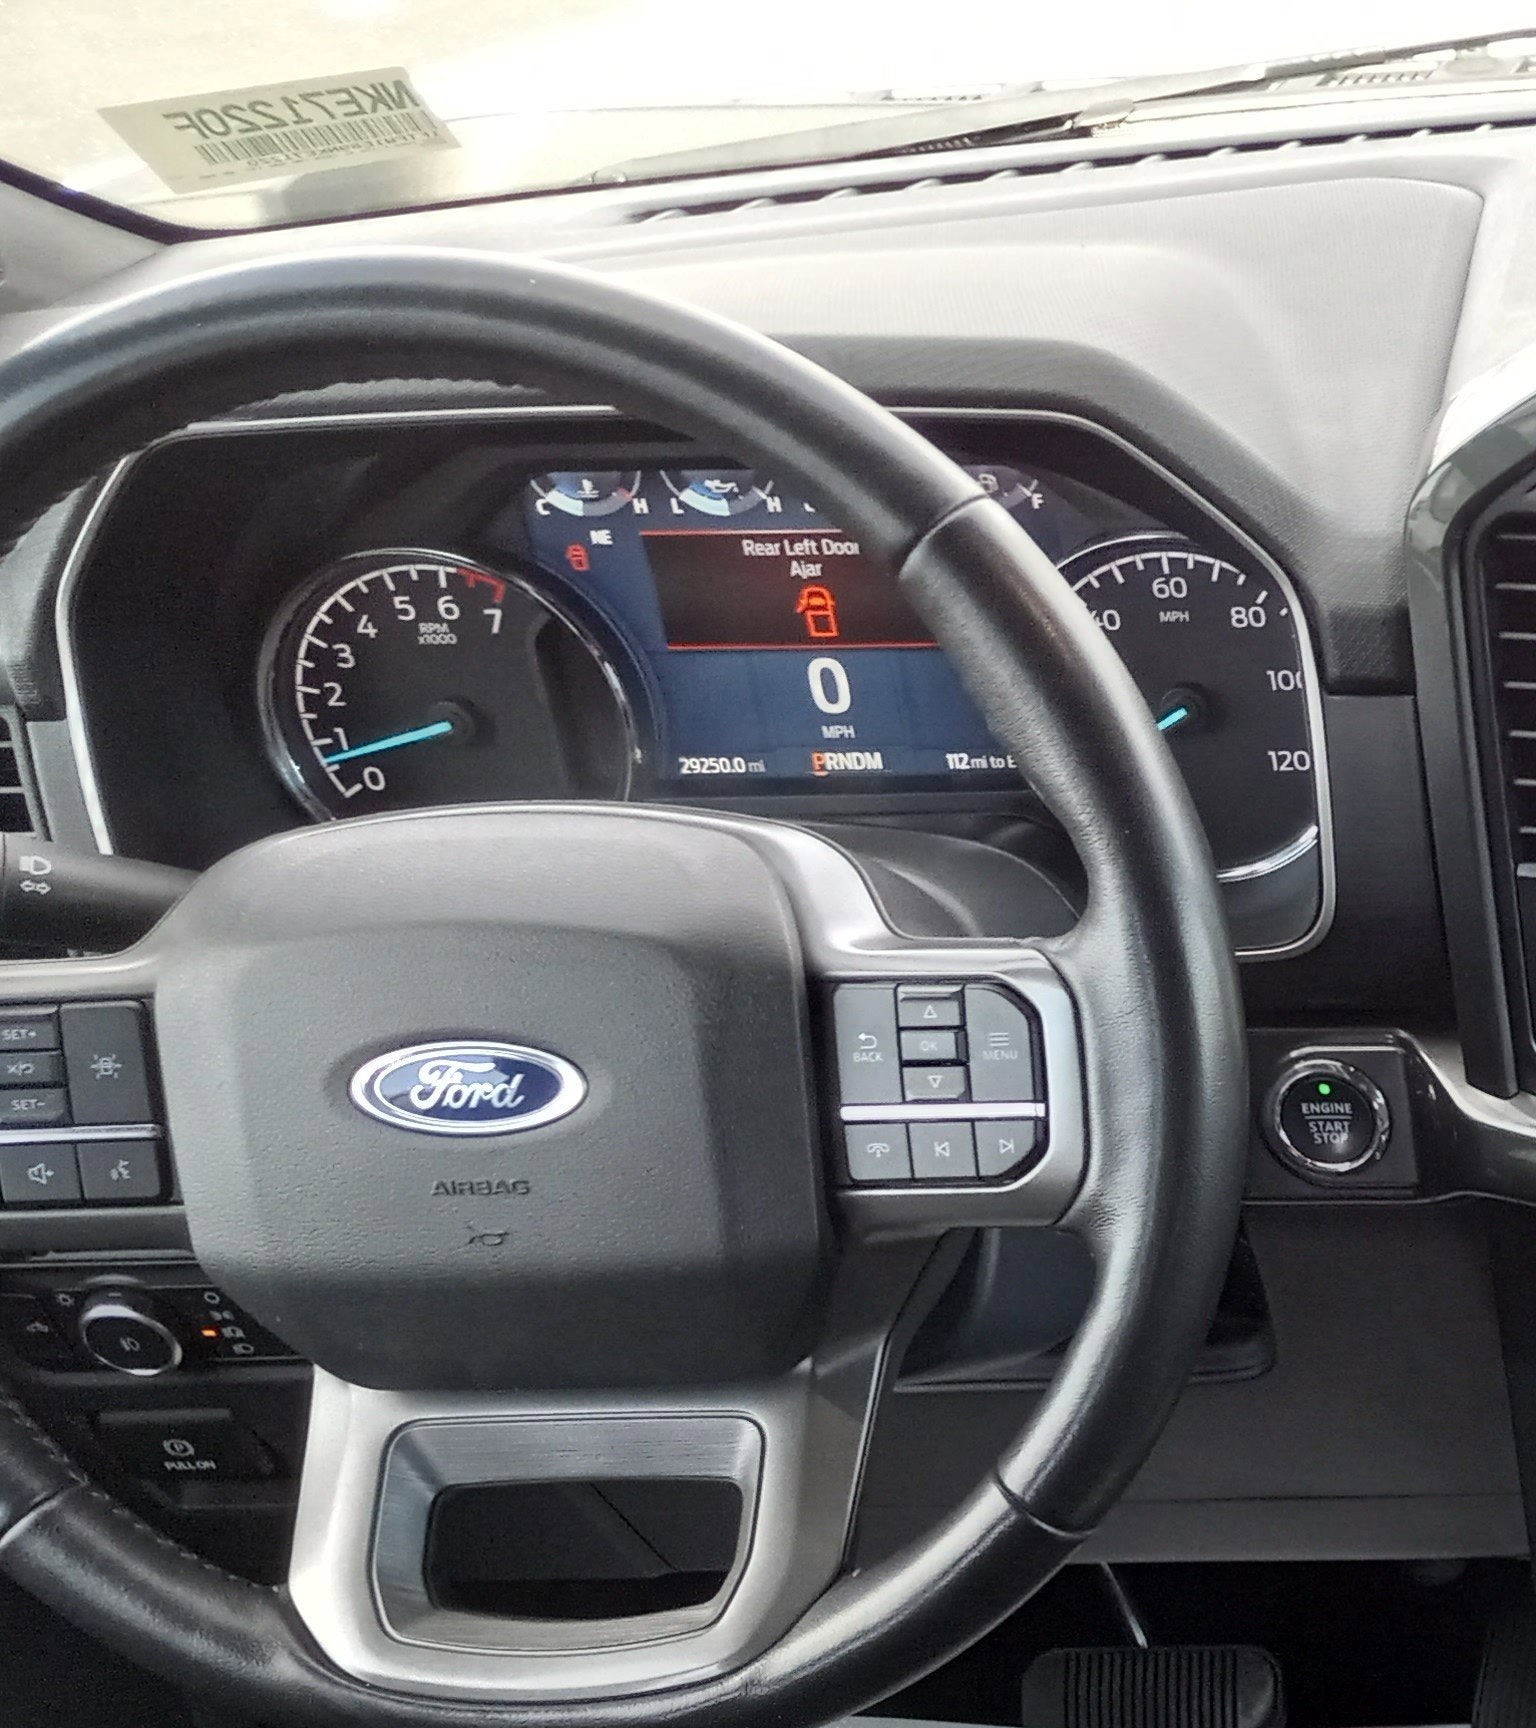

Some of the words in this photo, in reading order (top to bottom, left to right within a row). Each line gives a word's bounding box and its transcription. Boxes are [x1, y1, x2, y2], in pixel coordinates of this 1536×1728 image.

[536, 499, 550, 516] C
[633, 499, 650, 514] H
[671, 499, 684, 515] L
[766, 498, 782, 513] H
[589, 530, 613, 545] NE
[742, 540, 781, 556] Rear
[785, 539, 818, 556] Left
[790, 561, 822, 578] Ajar
[1152, 577, 1187, 599] 60
[393, 596, 416, 621] 5
[437, 595, 460, 620] 6
[483, 608, 502, 634] 7
[1159, 611, 1189, 622] MPH
[1230, 606, 1266, 628] 80
[357, 614, 378, 638] 4
[418, 622, 449, 633] RPM
[332, 643, 356, 669] 3
[323, 682, 347, 706] 2
[806, 657, 851, 715] 0
[333, 727, 349, 751] 1
[821, 725, 855, 739] MPH
[678, 757, 745, 774] 29250.0
[748, 760, 765, 773] mi
[945, 753, 969, 770] 112
[971, 755, 988, 769] mi
[989, 756, 1005, 769] to
[1268, 750, 1311, 772] 120
[363, 766, 386, 791] 0
[920, 1041, 938, 1051] OK
[853, 1051, 884, 1062] BACK
[983, 1050, 1018, 1060] MENU
[410, 1059, 525, 1110] Ford
[1301, 1102, 1353, 1114] ENGINE
[1308, 1121, 1351, 1133] START
[1313, 1132, 1349, 1144] STOP
[431, 1180, 530, 1196] AIRBAG
